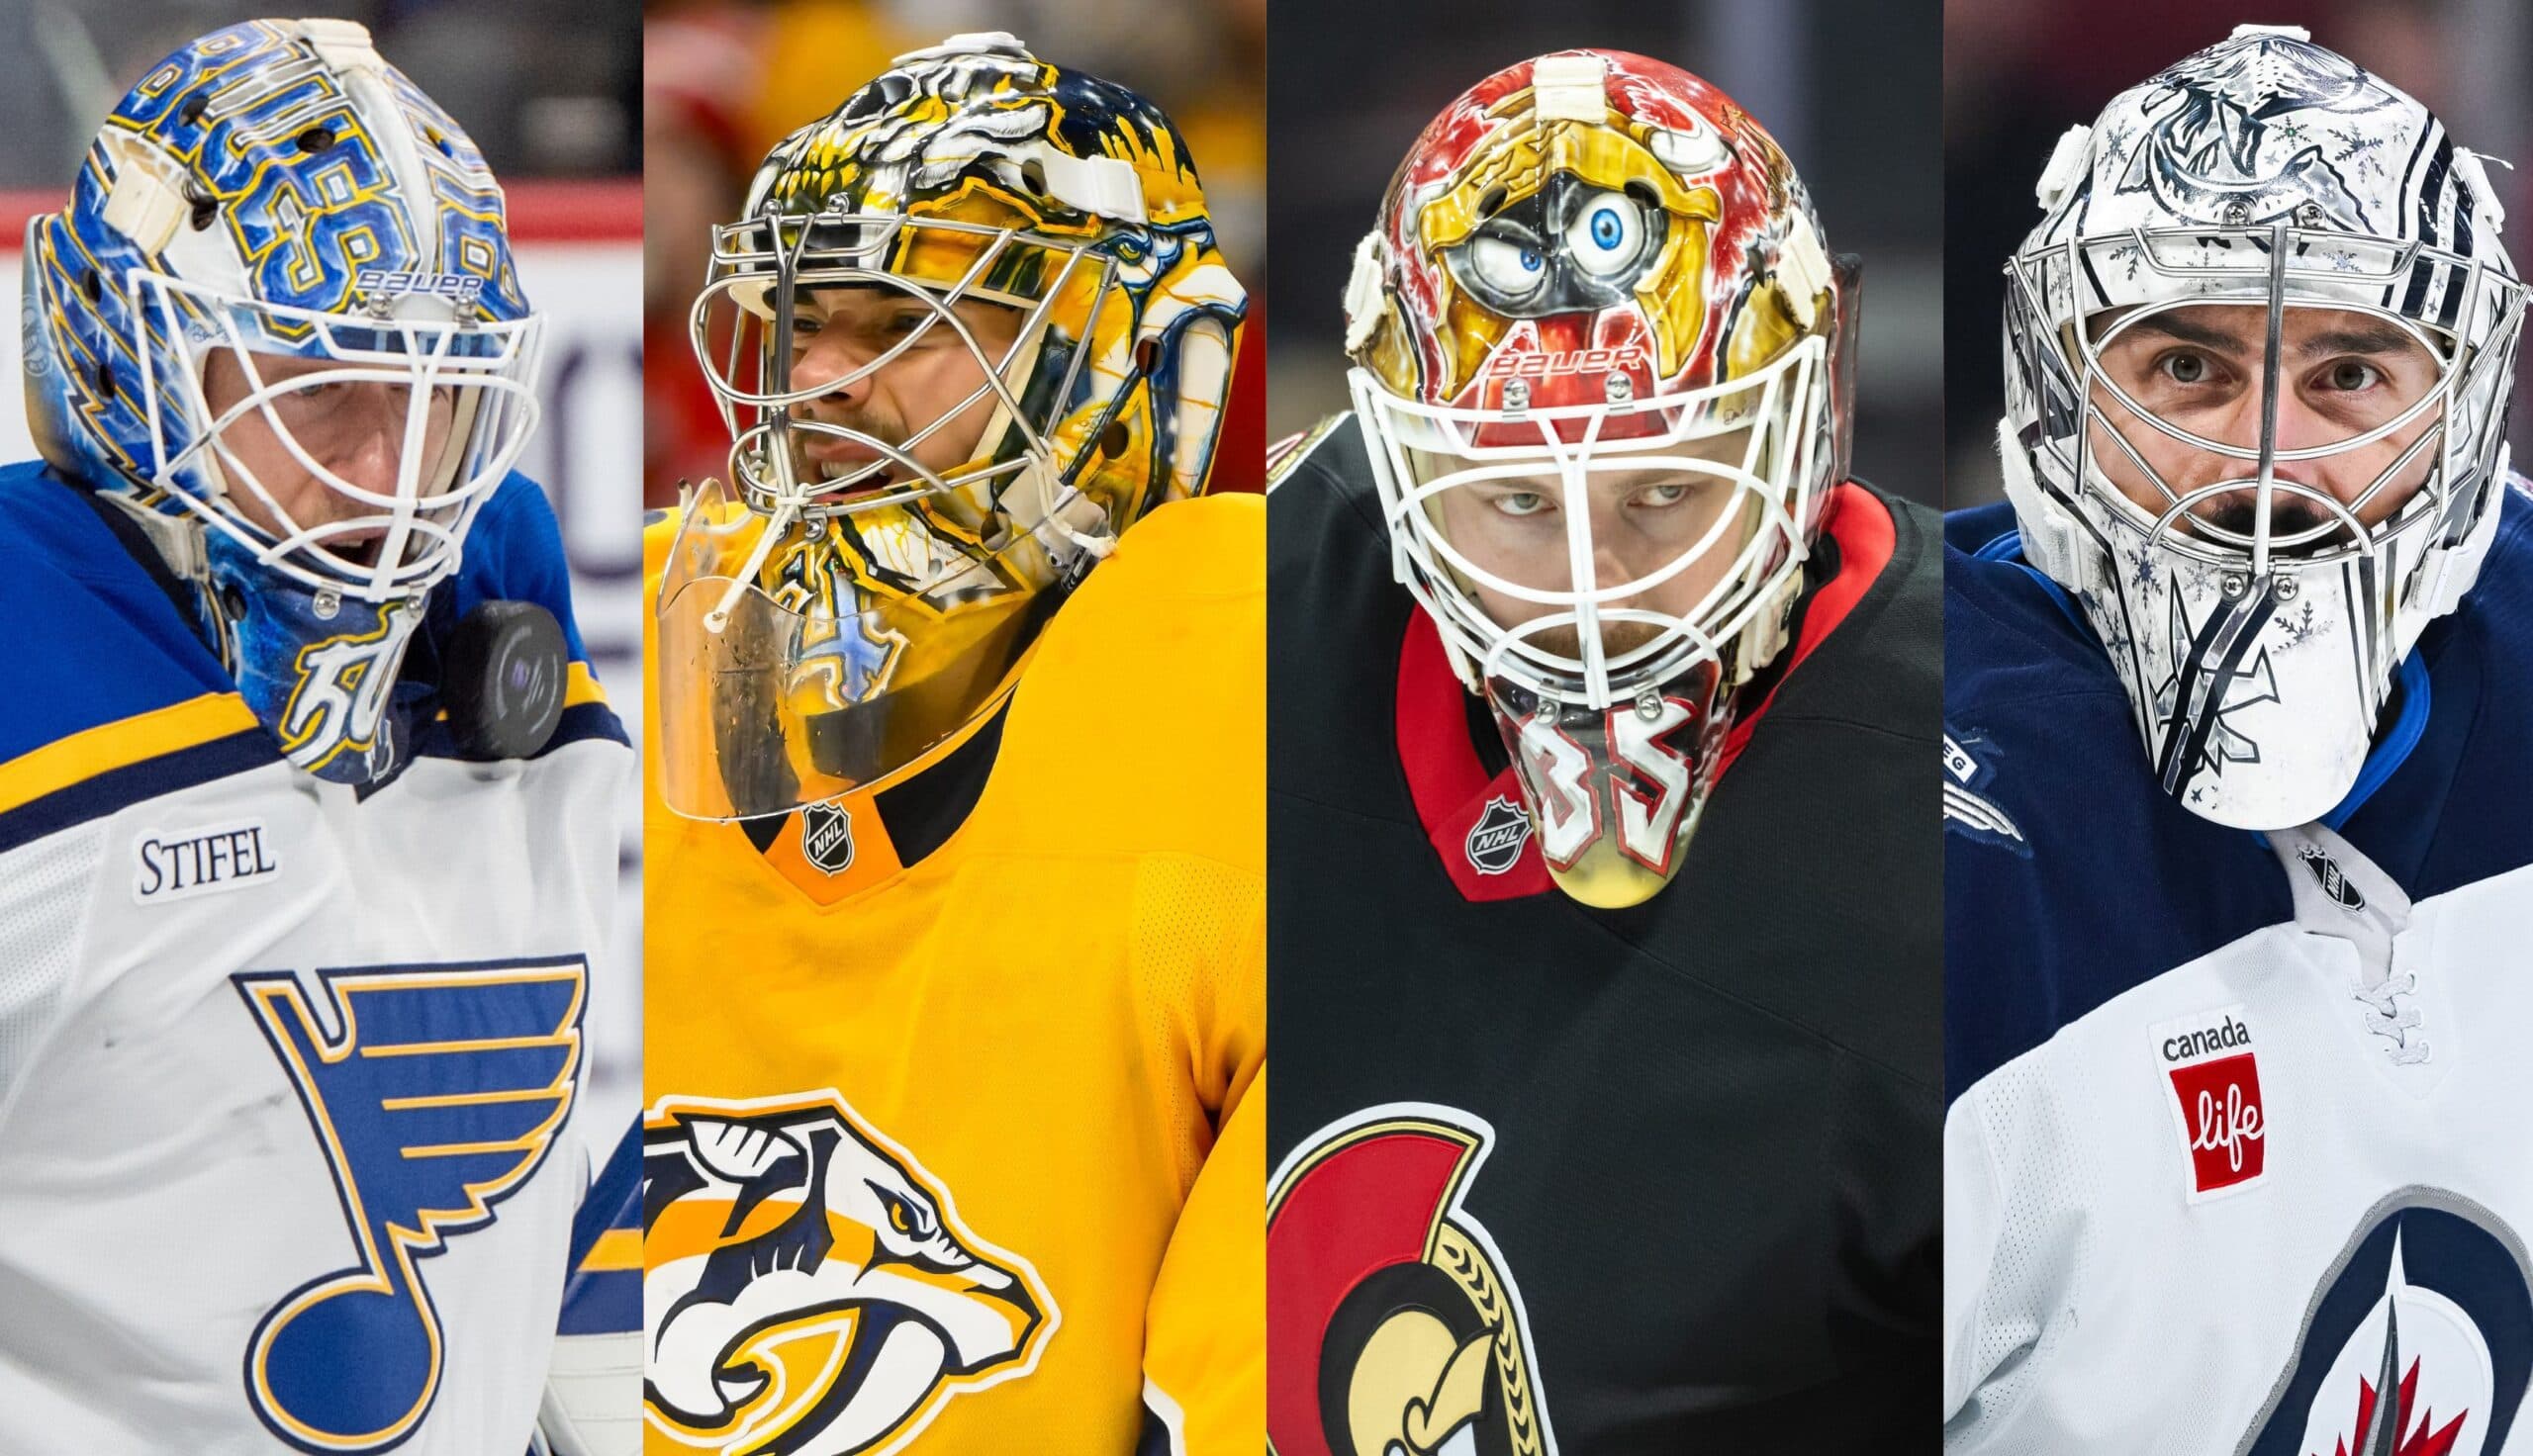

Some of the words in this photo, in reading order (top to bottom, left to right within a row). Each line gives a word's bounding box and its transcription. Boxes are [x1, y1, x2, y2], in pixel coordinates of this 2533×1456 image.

[105, 18, 422, 346] BLUES
[356, 271, 483, 295] BAUER
[1488, 347, 1642, 378] BAUER
[1518, 696, 1696, 878] 35
[141, 826, 276, 895] STIFEL
[814, 821, 843, 858] NHL
[1475, 825, 1521, 852] NHL
[2163, 1015, 2251, 1061] canada
[2193, 1083, 2264, 1172] life
